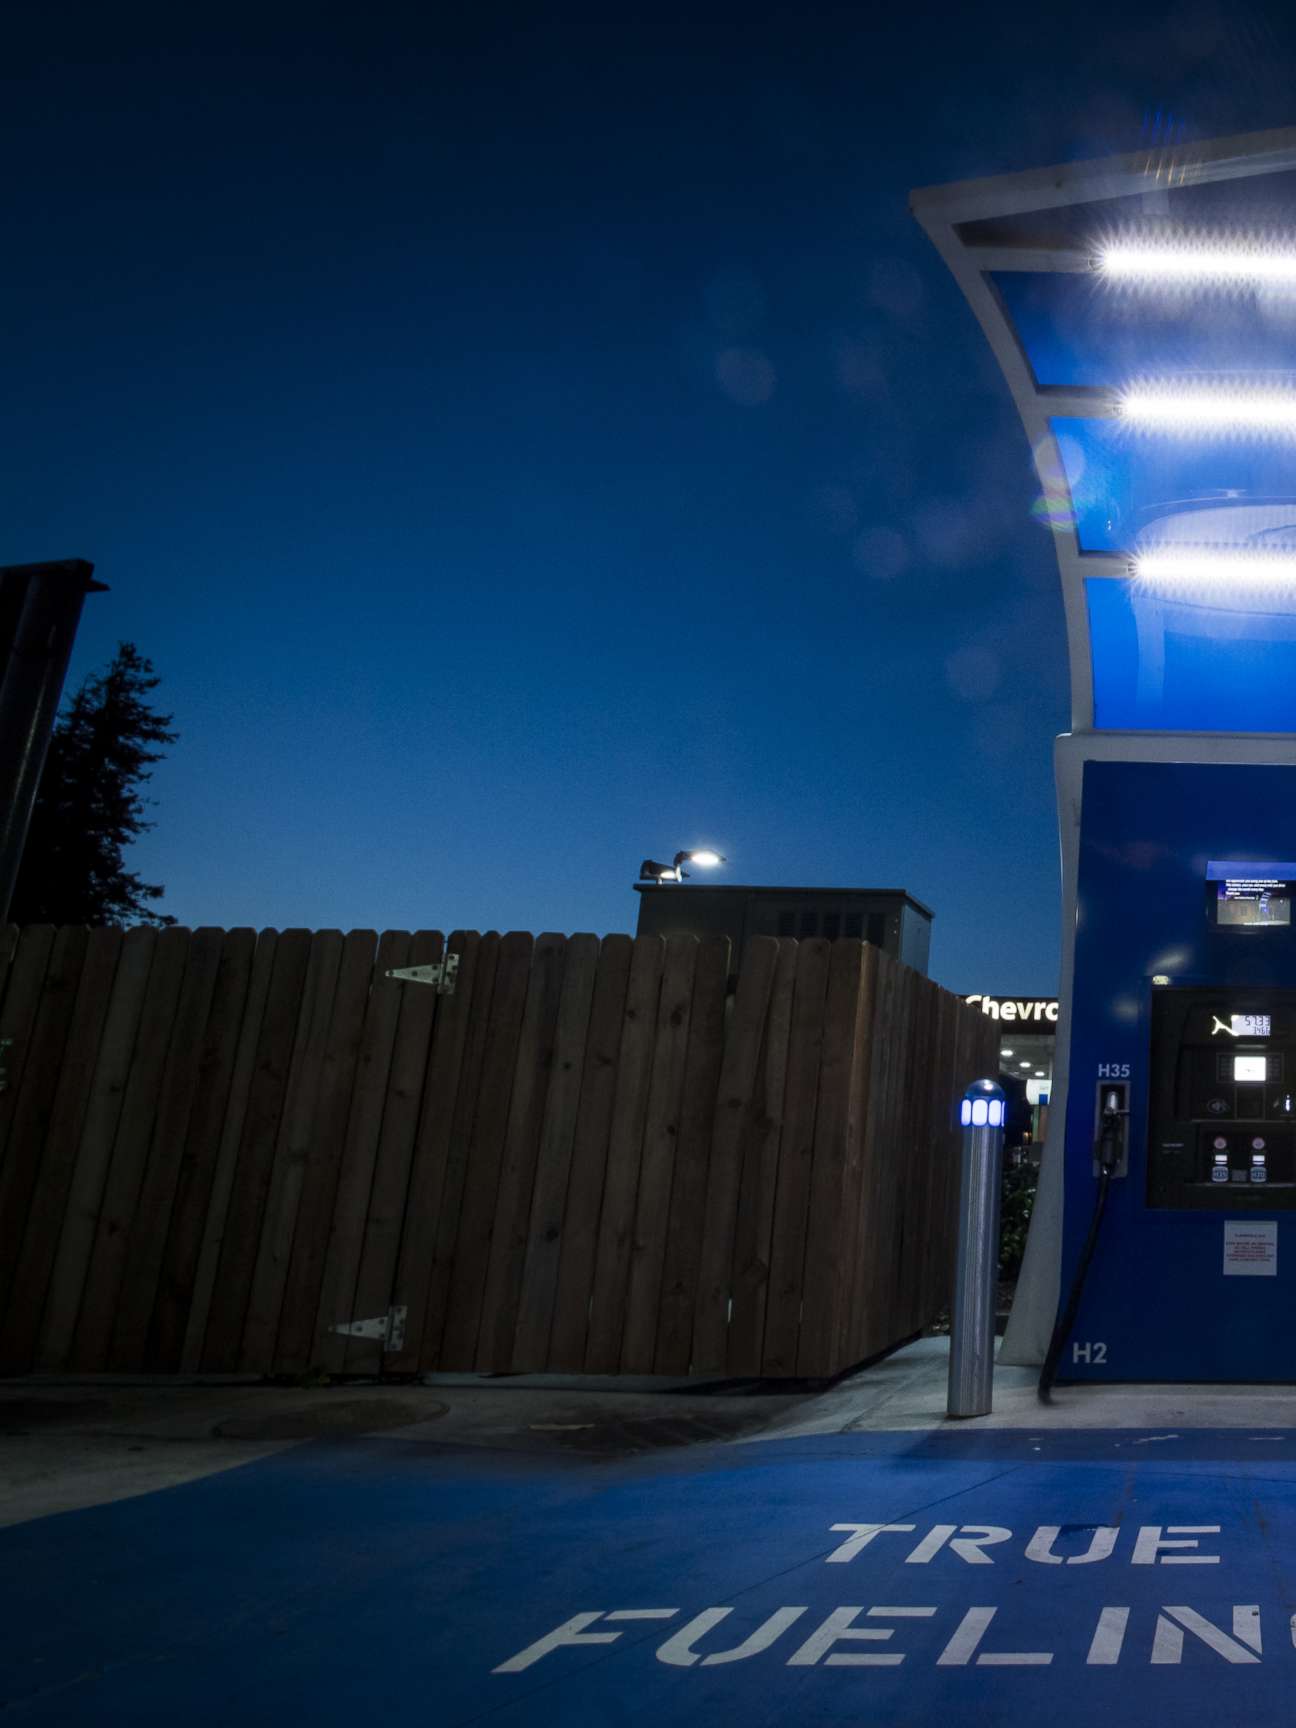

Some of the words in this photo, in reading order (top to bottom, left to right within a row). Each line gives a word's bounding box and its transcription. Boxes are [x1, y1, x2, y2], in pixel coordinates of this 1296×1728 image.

[1098, 1064, 1130, 1078] H35
[1072, 1341, 1107, 1364] H2
[825, 1523, 1220, 1565] TRUE
